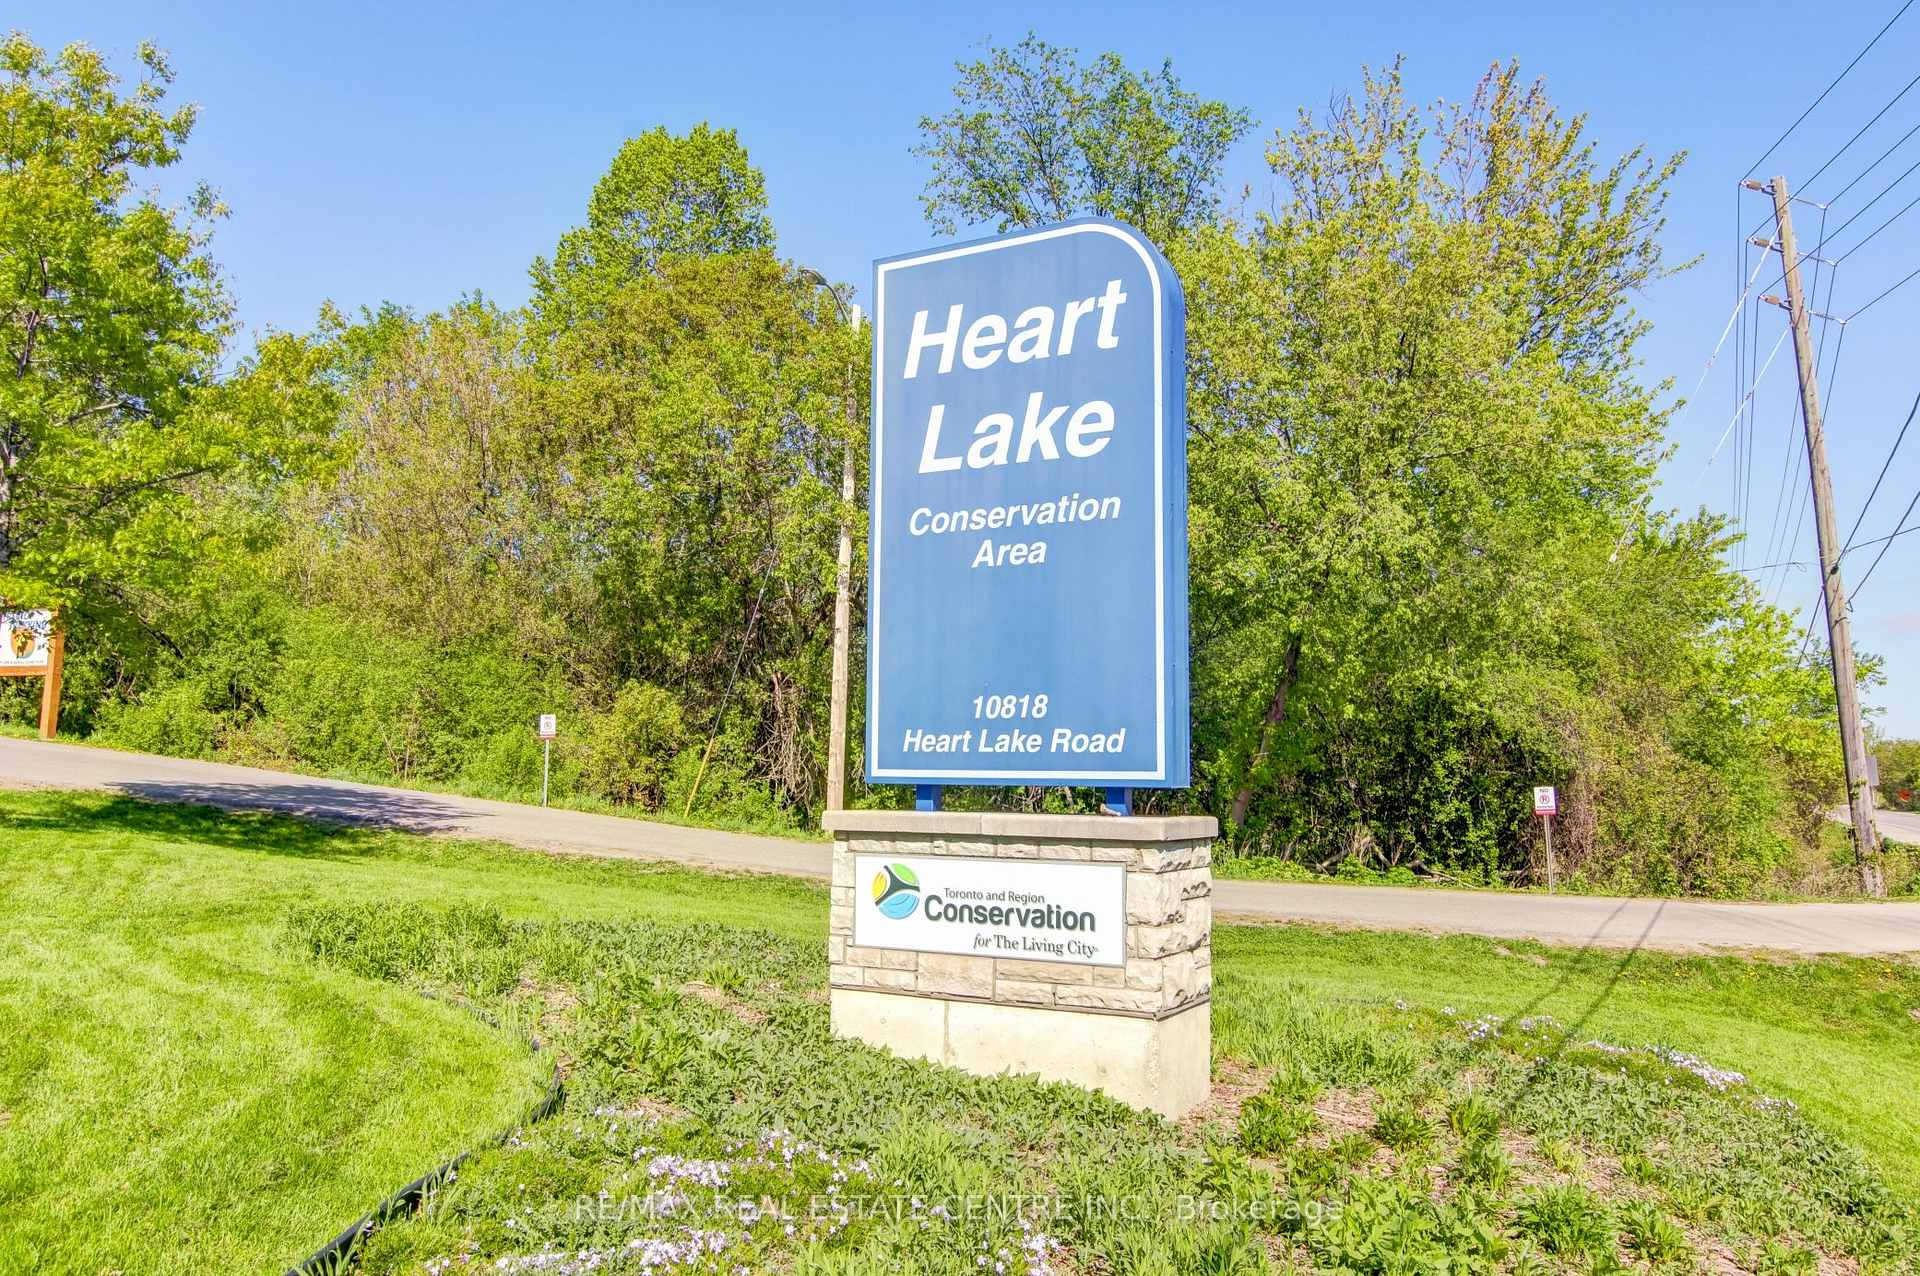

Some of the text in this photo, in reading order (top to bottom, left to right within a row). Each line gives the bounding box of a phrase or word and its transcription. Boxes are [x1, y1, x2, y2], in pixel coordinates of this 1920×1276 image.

[904, 279, 1127, 379] Heart
[918, 391, 1115, 474] Lake
[909, 493, 1121, 536] Conservation
[971, 539, 1048, 568] Area
[973, 694, 1048, 719] 10818
[902, 728, 1126, 753] Heart Lake Road
[944, 887, 1046, 906] Toronto and Region
[924, 895, 1096, 932] Conservation
[973, 933, 992, 949] for
[994, 934, 1019, 950] The
[1022, 937, 1064, 957] Living
